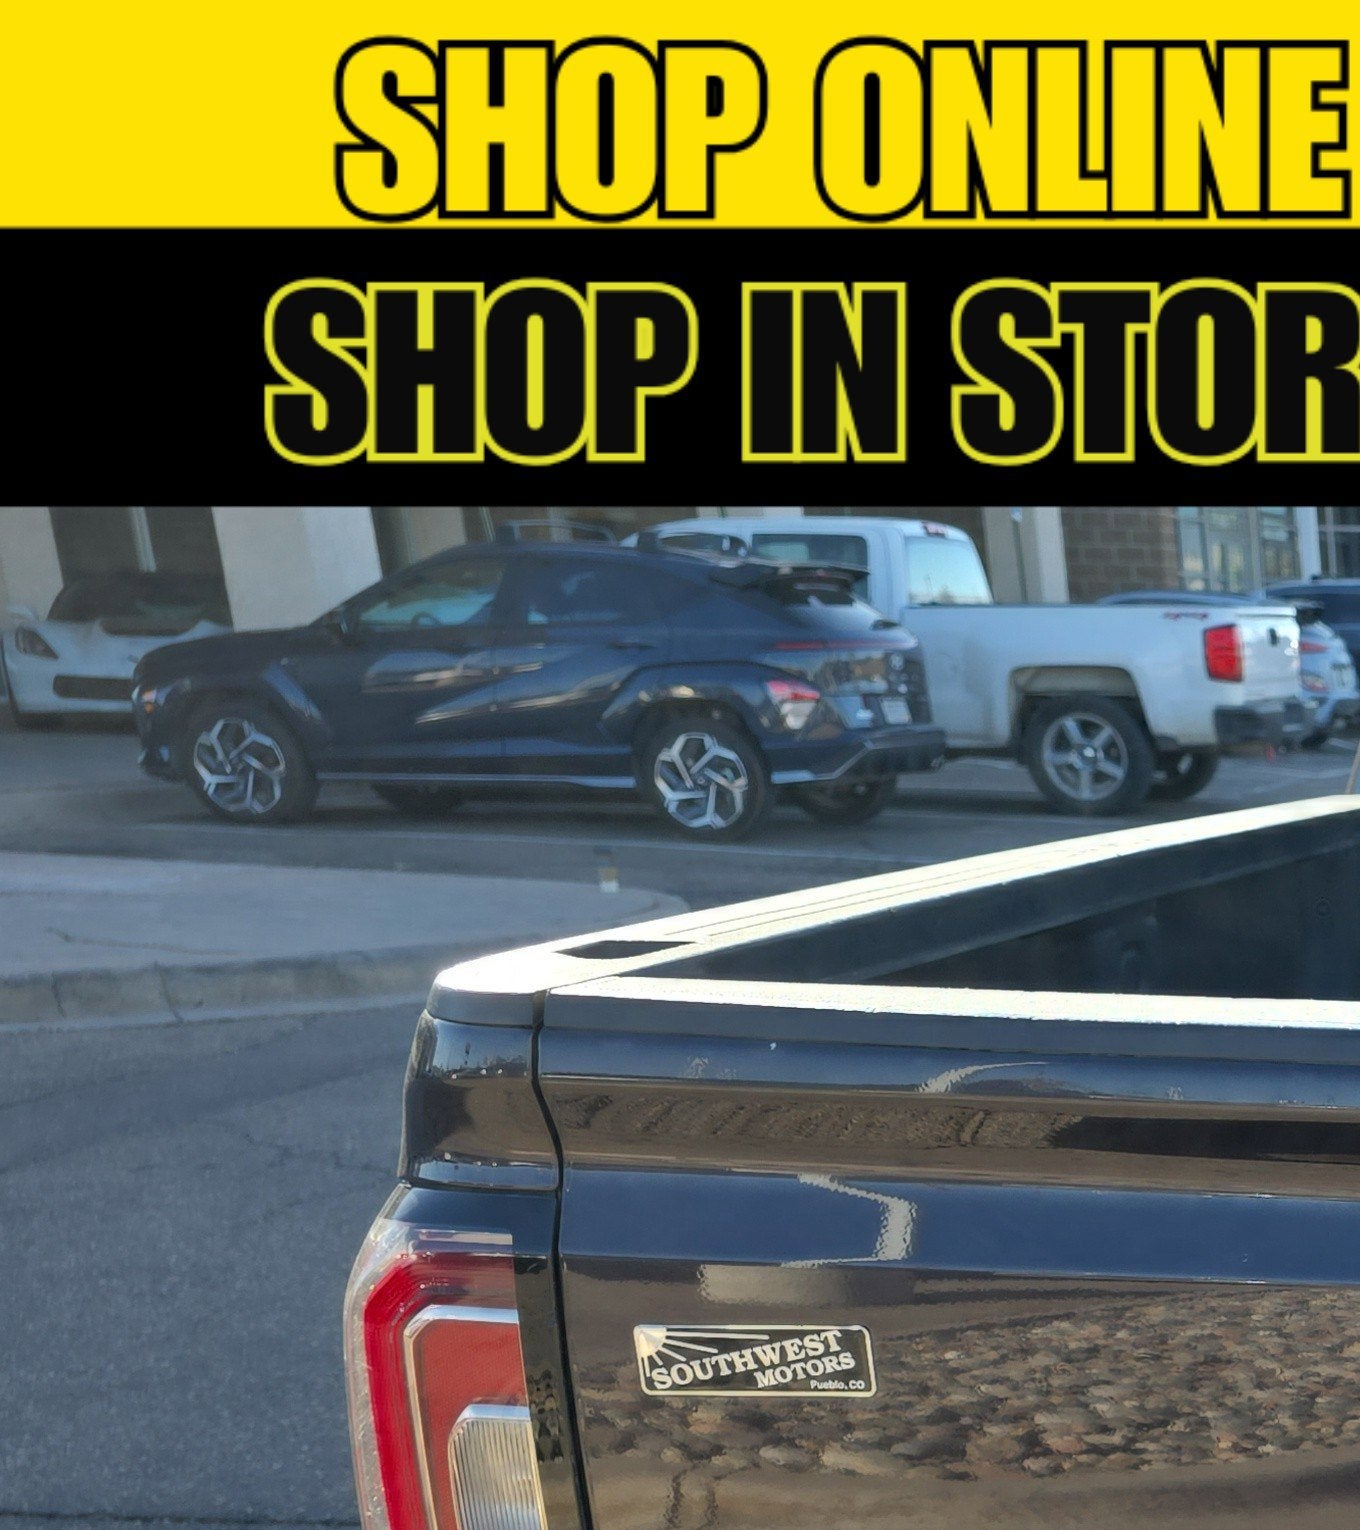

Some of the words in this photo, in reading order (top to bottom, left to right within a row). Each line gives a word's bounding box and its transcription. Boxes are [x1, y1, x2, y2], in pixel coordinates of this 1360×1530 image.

[651, 1329, 842, 1390] SOUTHWEST
[754, 1352, 856, 1388] MOTORS
[849, 1379, 865, 1390] CO
